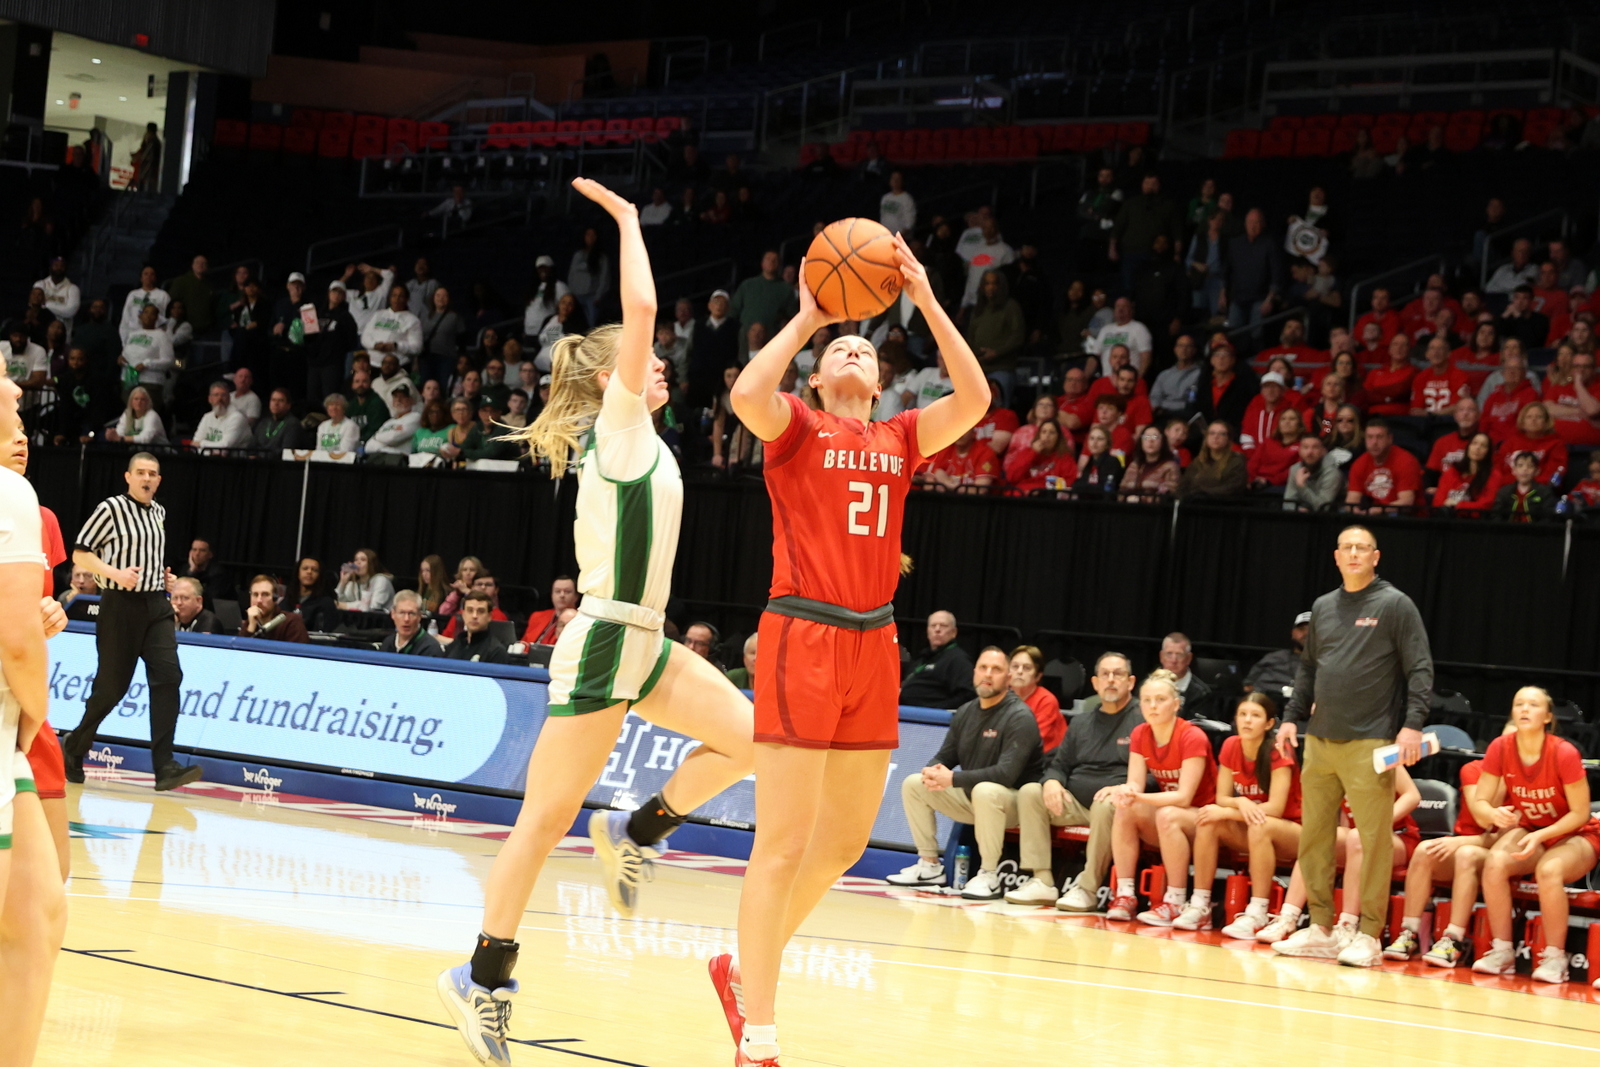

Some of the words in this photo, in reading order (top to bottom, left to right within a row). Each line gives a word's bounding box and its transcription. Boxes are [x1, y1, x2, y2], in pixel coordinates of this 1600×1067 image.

[823, 449, 904, 477] BELLEVUE
[848, 481, 889, 537] 21
[178, 681, 230, 721] nd
[229, 681, 444, 756] fundraising.
[253, 768, 283, 789] Kroger
[425, 793, 458, 815] Kroger
[1520, 801, 1559, 819] 24
